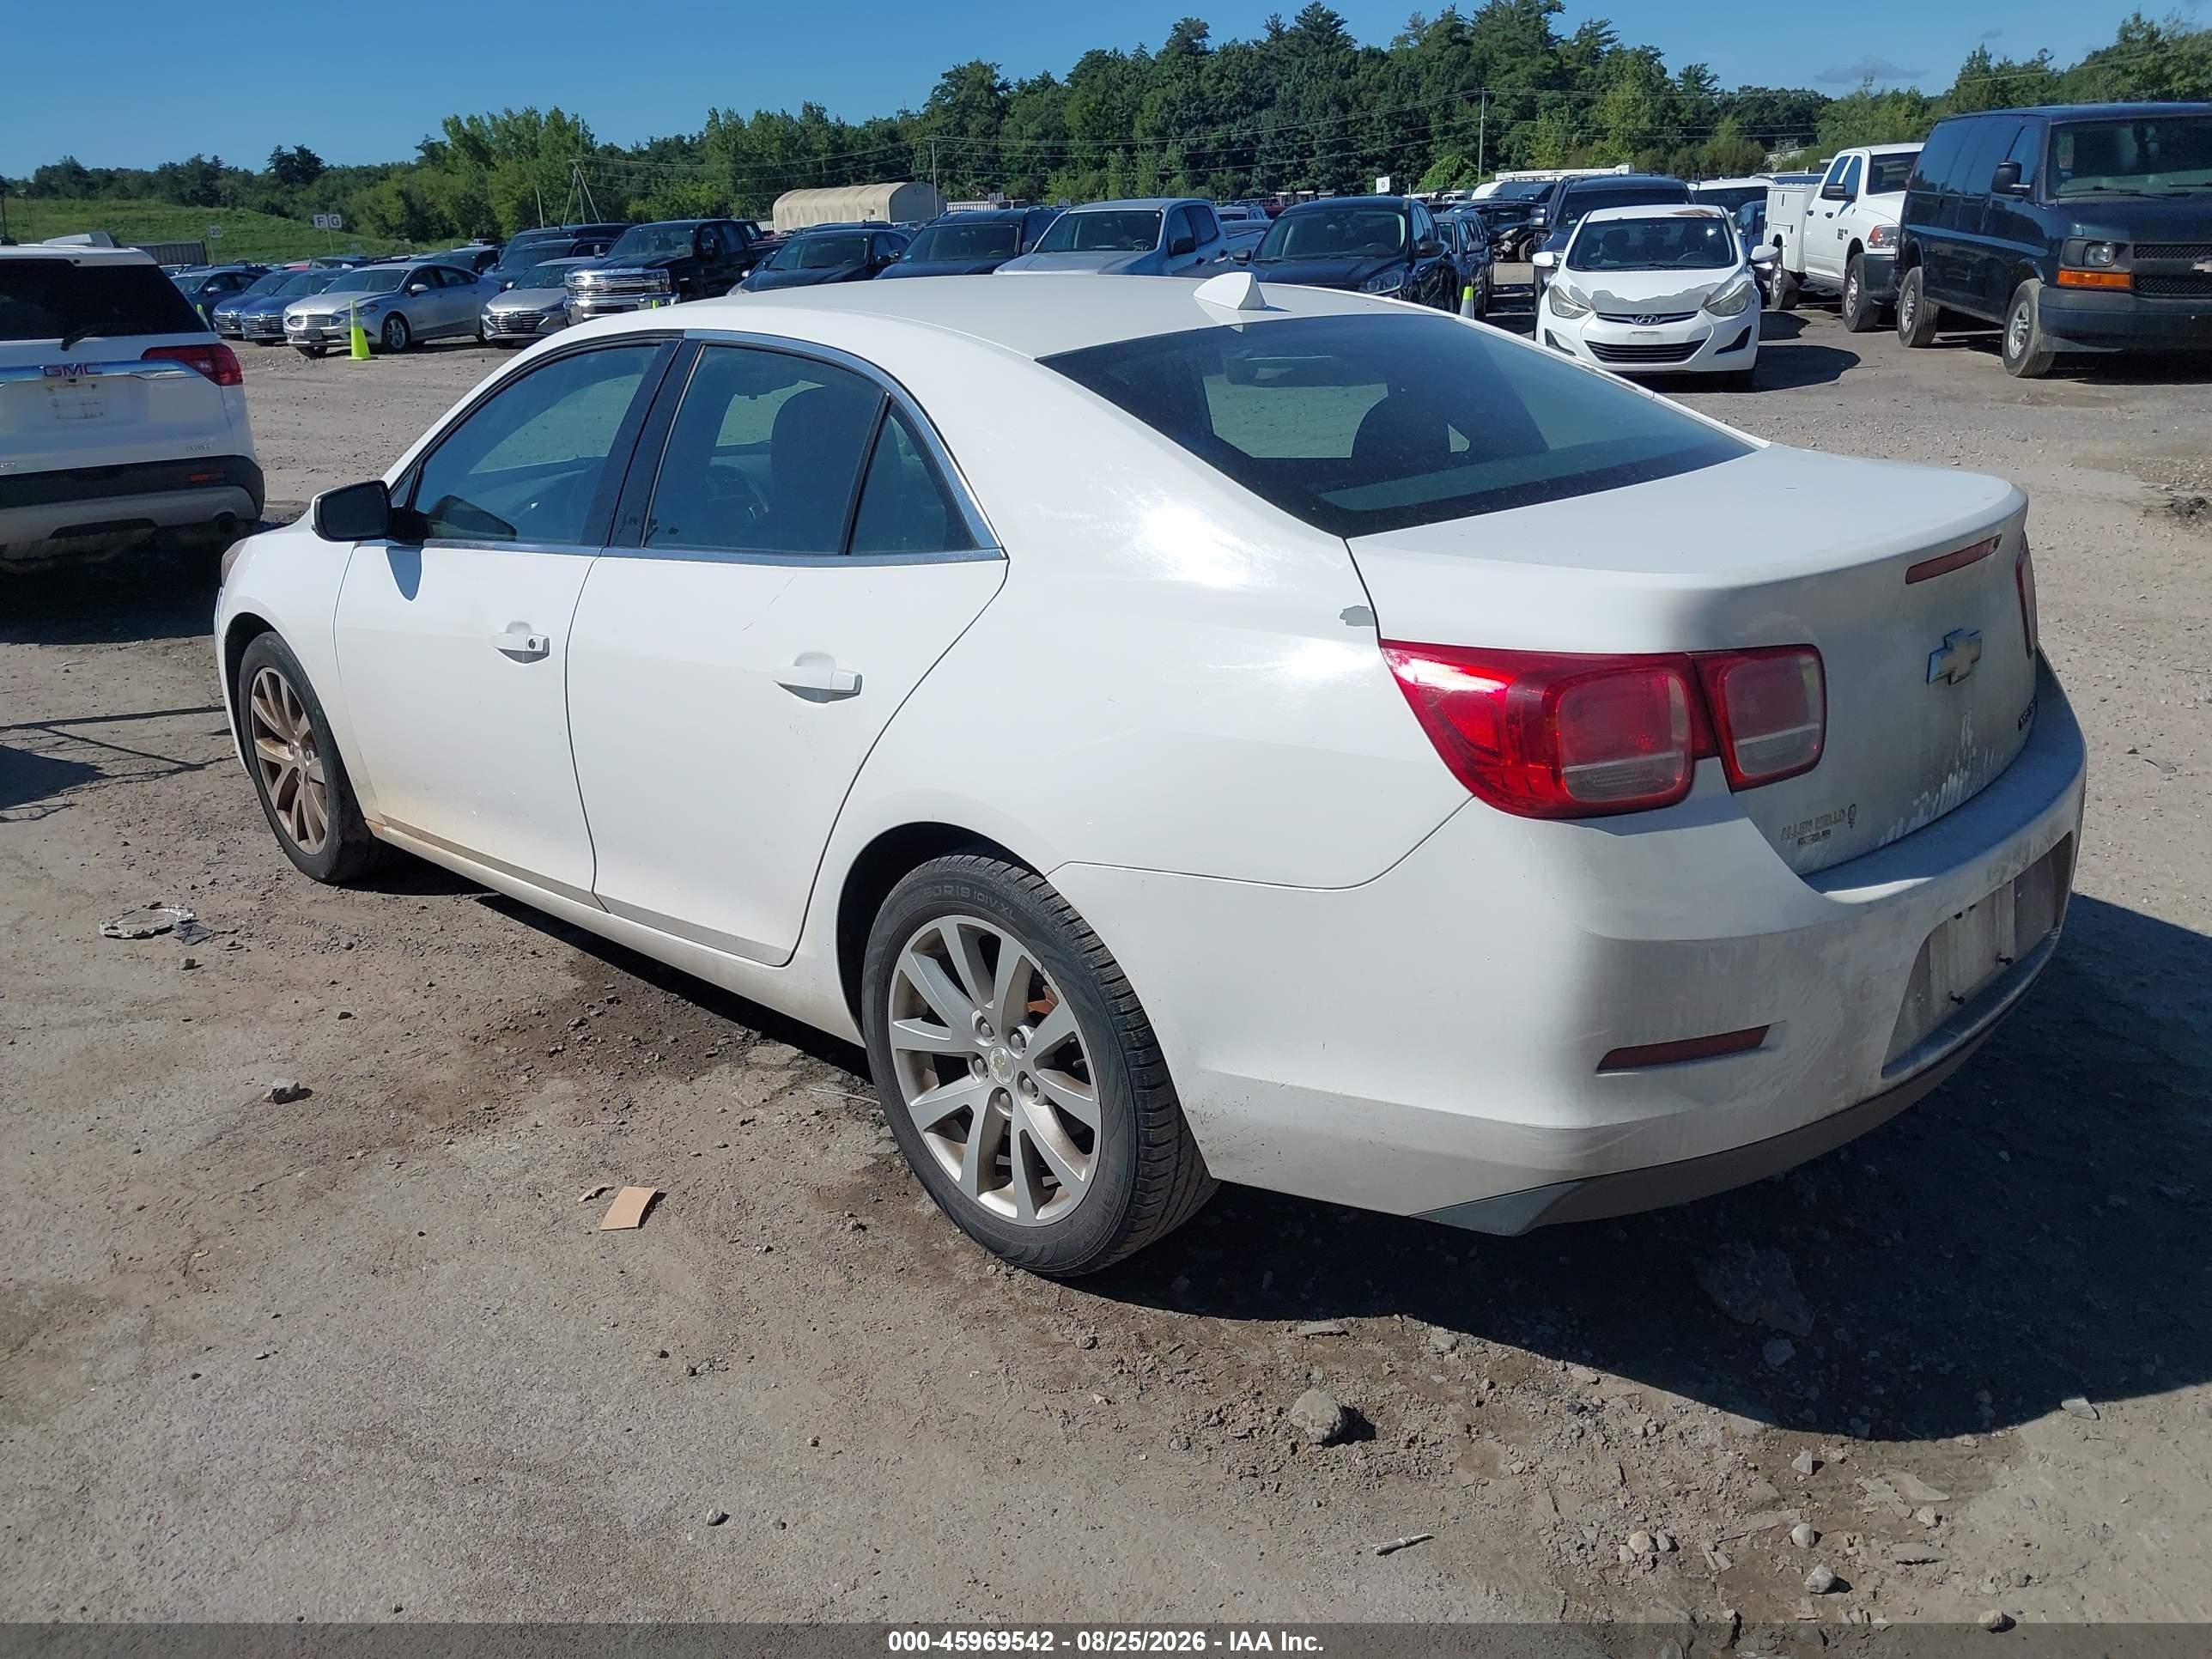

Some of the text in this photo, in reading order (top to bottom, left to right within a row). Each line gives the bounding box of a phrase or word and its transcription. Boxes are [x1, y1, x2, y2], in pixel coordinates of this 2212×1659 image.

[317, 216, 324, 227] F
[331, 216, 340, 227] G
[42, 363, 103, 378] GMC
